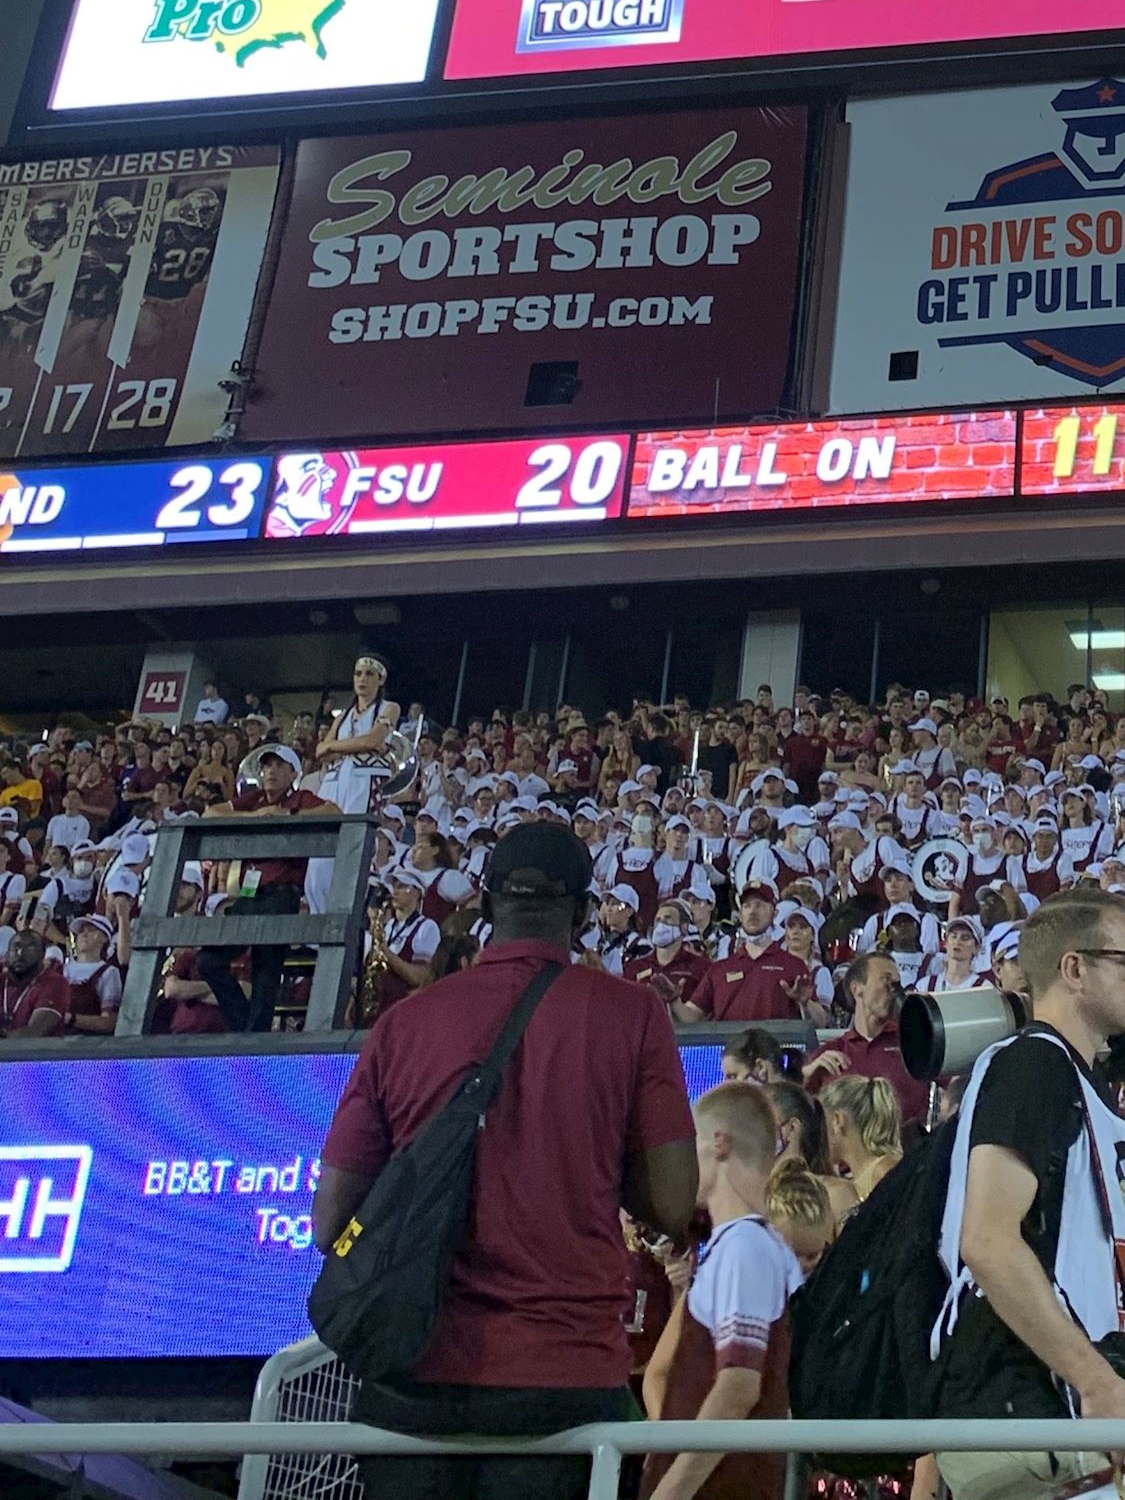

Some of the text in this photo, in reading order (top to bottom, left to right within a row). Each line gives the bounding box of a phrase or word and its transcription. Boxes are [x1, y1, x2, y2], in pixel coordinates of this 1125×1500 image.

[140, 182, 164, 244] DUNN
[309, 131, 773, 243] Seminole
[68, 187, 95, 249] WARD
[930, 215, 1058, 270] DRIVE
[307, 213, 761, 288] SPORTSHOP
[916, 273, 998, 324] GET
[43, 383, 94, 434] 17
[107, 378, 178, 430] 28
[339, 440, 623, 509] FSU 20
[648, 436, 896, 493] BALL ON
[156, 462, 263, 529] 23
[144, 680, 178, 704] 41
[144, 1159, 229, 1196] BB&T
[237, 1157, 301, 1193] and
